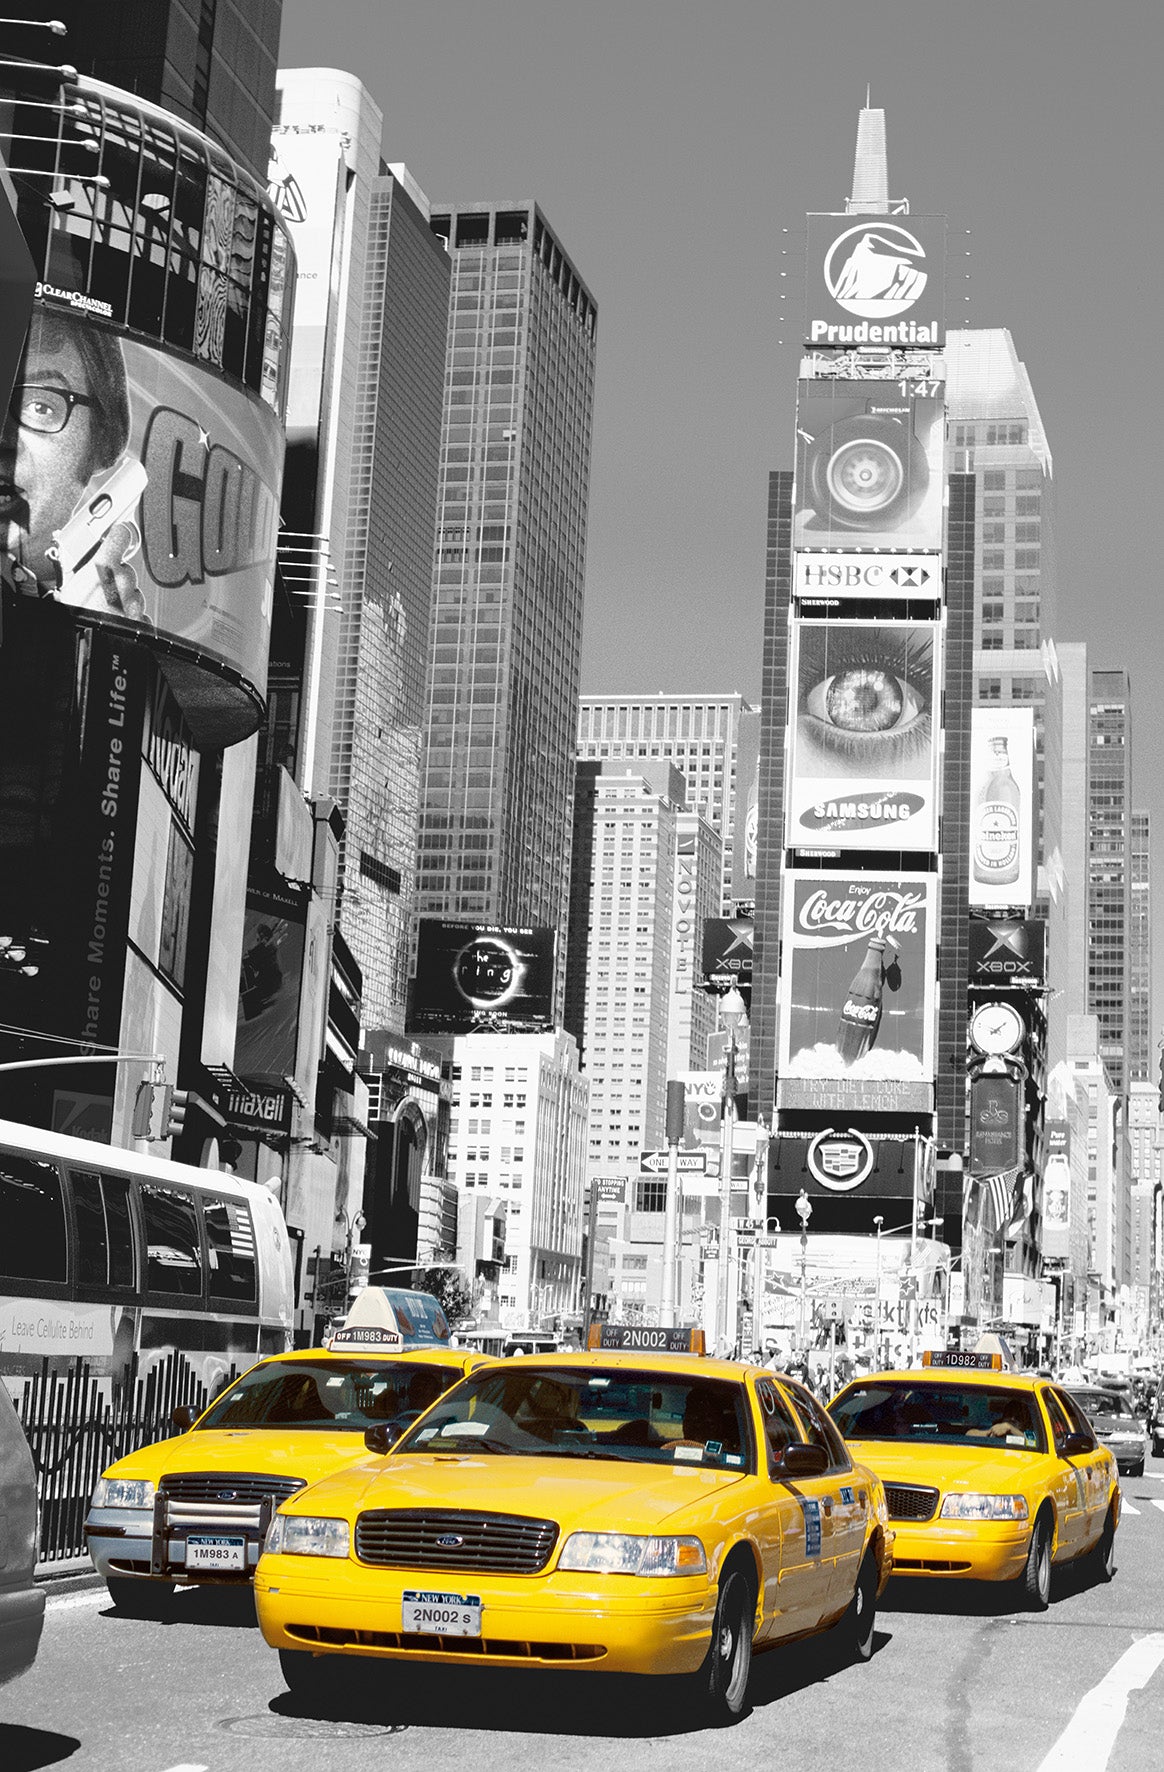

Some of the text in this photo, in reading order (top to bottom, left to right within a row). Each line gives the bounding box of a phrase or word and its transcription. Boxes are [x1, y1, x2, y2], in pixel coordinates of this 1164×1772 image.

[811, 320, 938, 343] Prudential
[898, 381, 941, 398] 1:47
[804, 564, 884, 587] HSBC
[814, 802, 911, 822] SAMSUNG
[87, 829, 115, 964] Moments.
[101, 741, 124, 818] Share
[849, 885, 871, 896] Enjoy
[675, 858, 694, 994] NOVOTEL
[716, 958, 754, 970] XBO
[976, 961, 1031, 973] XBOX
[803, 1080, 911, 1095] TRY DIET COKE
[228, 1092, 285, 1122] maxell
[812, 1094, 899, 1110] WITH LEMON
[649, 1159, 699, 1167] ONE WAY
[12, 1316, 35, 1337] Leave
[69, 1320, 94, 1340] Behind
[605, 1329, 618, 1337] OFF
[336, 1332, 352, 1341] OFF
[352, 1331, 382, 1341] 1M983
[623, 1330, 667, 1348] 2N002
[672, 1331, 685, 1340] OFF
[603, 1339, 620, 1347] DUTY
[669, 1341, 687, 1351] DUTY
[945, 1354, 976, 1367] 1D982
[194, 1549, 230, 1559] 1M983
[421, 1594, 462, 1604] NEW YORK
[413, 1609, 459, 1623] 2N002
